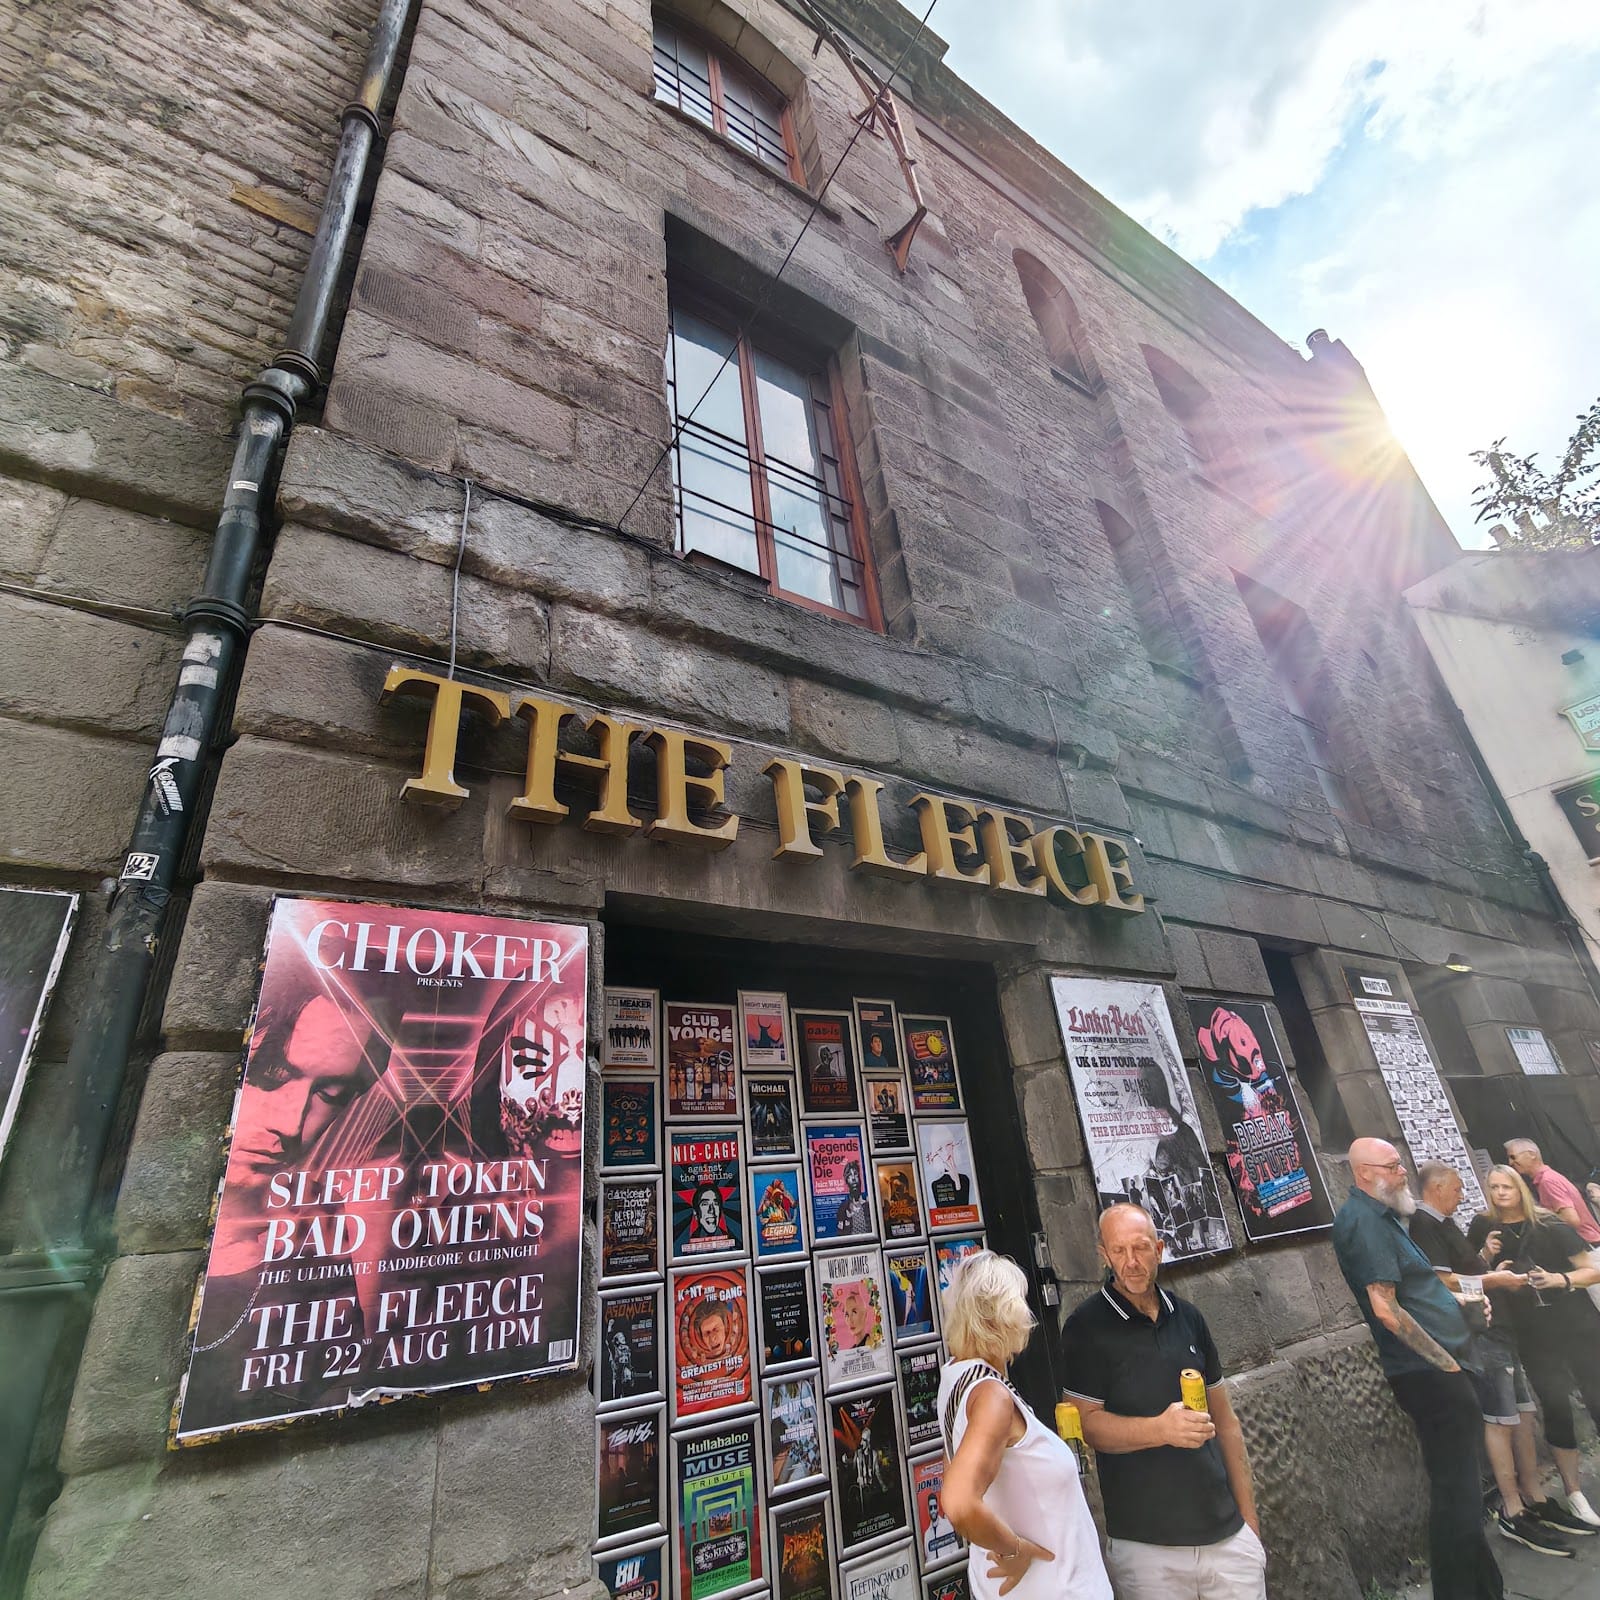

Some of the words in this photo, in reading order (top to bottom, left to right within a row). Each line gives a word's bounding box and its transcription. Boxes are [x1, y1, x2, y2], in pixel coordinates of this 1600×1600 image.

[380, 664, 739, 848] THE
[760, 757, 1145, 914] FLEECE
[306, 919, 564, 984] CHOKER
[416, 976, 464, 989] PRESENTS
[619, 999, 652, 1008] MEAKER
[681, 1014, 720, 1027] CLUB
[669, 1026, 733, 1043] YONCÉ
[807, 1027, 840, 1036] oasis
[1075, 1056, 1091, 1068] UK
[1091, 1056, 1100, 1068] &
[1100, 1056, 1112, 1068] EU
[1113, 1056, 1137, 1068] TOUR
[751, 1084, 786, 1093] MICHAEL
[811, 1082, 831, 1094] live
[1088, 1113, 1122, 1123] TUESDAY
[1136, 1109, 1170, 1120] OCTOBER
[1090, 1126, 1109, 1138] THE
[1109, 1123, 1141, 1137] FLEECE
[1141, 1121, 1173, 1134] BRISTOL
[1232, 1111, 1294, 1153] BREAK
[673, 1141, 737, 1163] NIC-CAGE
[811, 1141, 859, 1154] Legends
[813, 1154, 846, 1166] Never
[1244, 1141, 1299, 1184] STUFF
[687, 1163, 723, 1175] against
[814, 1166, 833, 1178] Die
[266, 1166, 405, 1210] SLEEP
[422, 1158, 551, 1199] TOKEN
[680, 1173, 695, 1183] the
[697, 1171, 733, 1182] machine
[261, 1213, 367, 1264] BAD
[391, 1199, 545, 1250] OMENS
[765, 1225, 794, 1237] LEGEND
[258, 1269, 291, 1286] THE
[297, 1261, 373, 1283] ULTIMATE
[377, 1251, 464, 1274] BADDIECORE
[468, 1244, 542, 1264] CLUBNIGHT
[828, 1258, 849, 1279] WENDY
[850, 1256, 870, 1276] JAMES
[889, 1258, 925, 1270] QUEEN
[706, 1294, 718, 1302] THE
[719, 1285, 743, 1301] GANG
[249, 1295, 357, 1352] THE
[376, 1273, 545, 1334] FLEECE
[783, 1310, 801, 1318] FLEECE
[776, 1319, 798, 1327] BRISTOL
[239, 1350, 308, 1393] FRI
[377, 1329, 450, 1370] AUG
[466, 1315, 543, 1356] 11PM
[681, 1361, 722, 1379] GREATEST
[725, 1355, 744, 1367] HITS
[683, 1395, 695, 1403] THE
[694, 1391, 713, 1401] FLEECE
[713, 1387, 736, 1397] BRISTOL
[686, 1433, 749, 1456] Hullabaloo
[685, 1449, 750, 1477] MUSE
[692, 1470, 745, 1489] TRIBUTE
[917, 1479, 932, 1493] JON
[853, 1529, 862, 1538] THE
[862, 1524, 879, 1536] FLEECE
[878, 1518, 896, 1530] BRISTOL
[713, 1543, 737, 1558] KEANE
